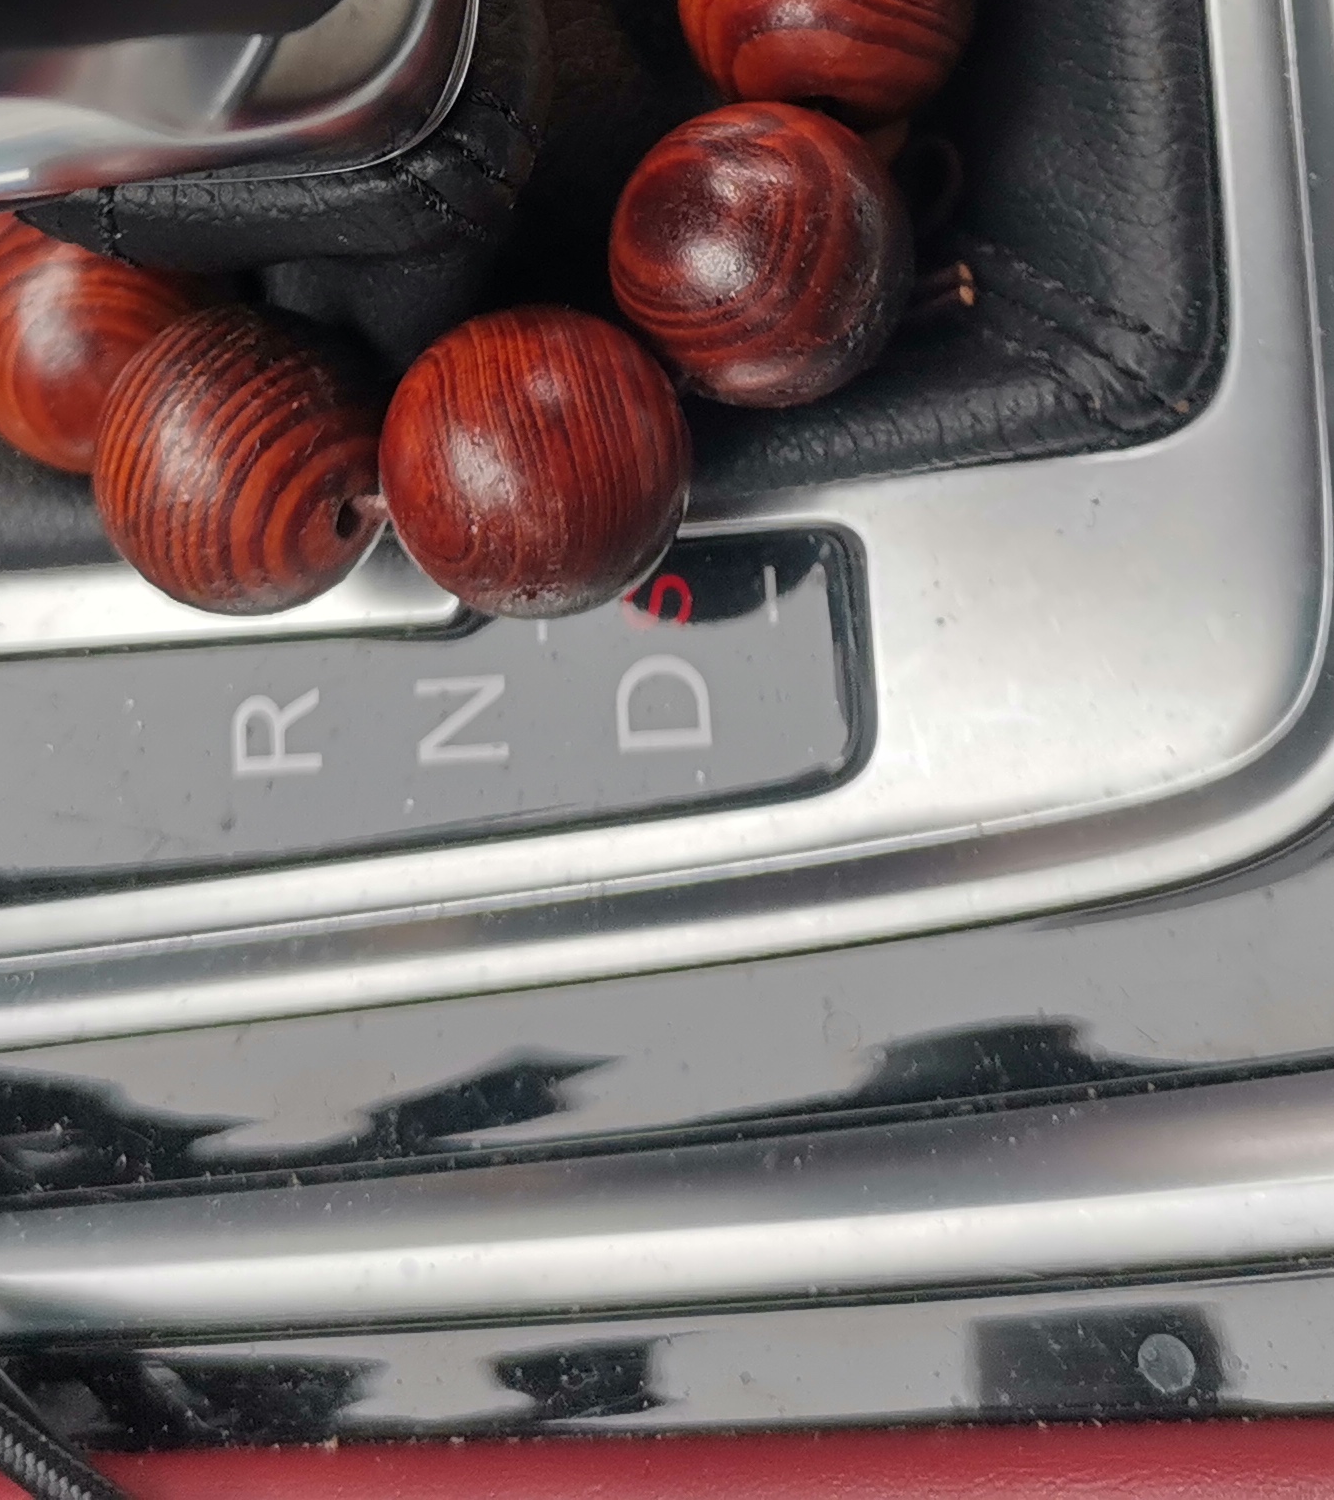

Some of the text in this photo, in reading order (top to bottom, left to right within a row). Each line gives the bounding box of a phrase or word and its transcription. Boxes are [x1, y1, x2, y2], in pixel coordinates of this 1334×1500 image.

[233, 687, 323, 776] R
[414, 673, 510, 763] N
[616, 654, 713, 752] D
